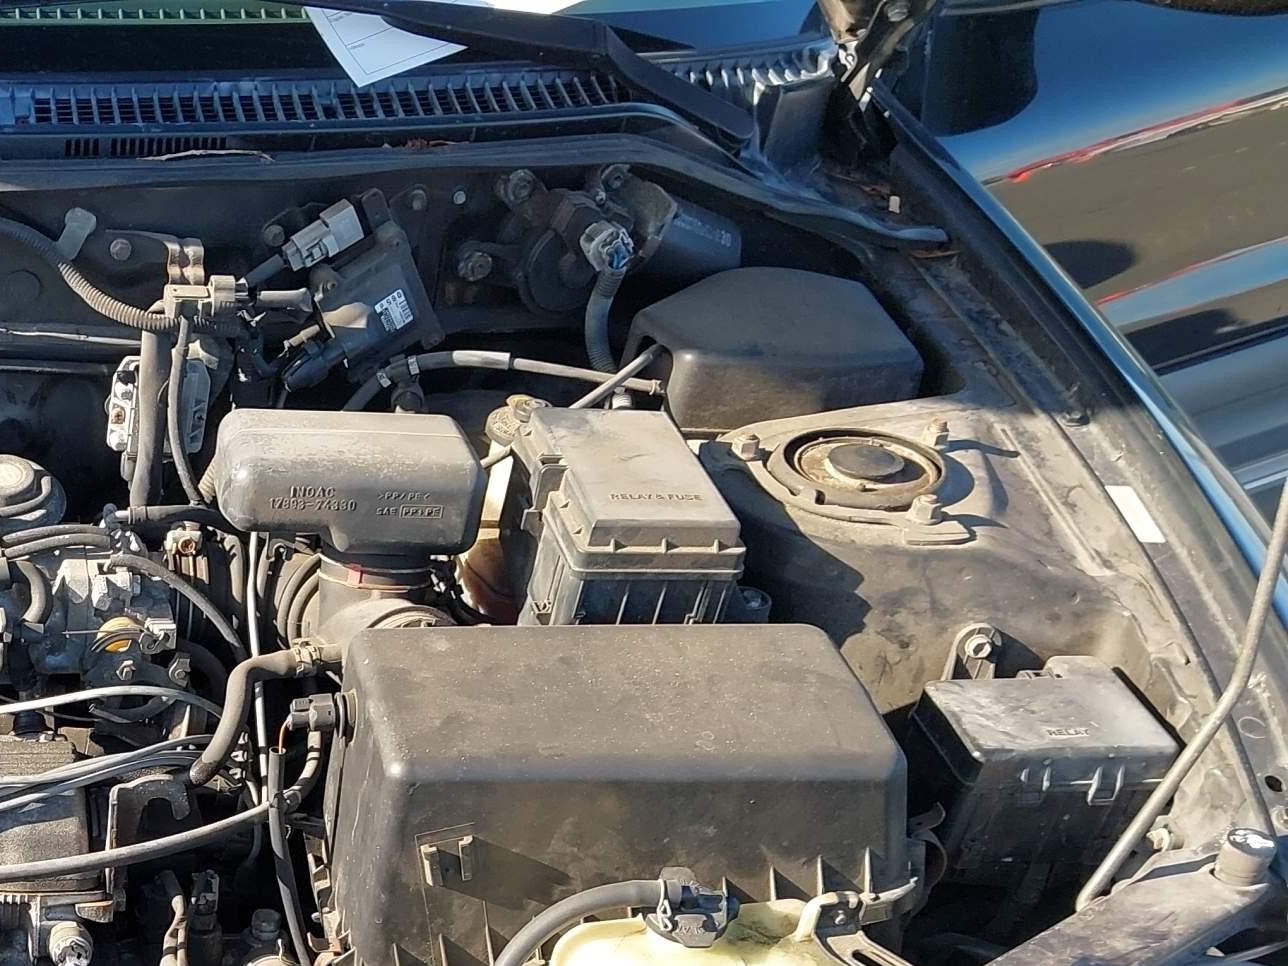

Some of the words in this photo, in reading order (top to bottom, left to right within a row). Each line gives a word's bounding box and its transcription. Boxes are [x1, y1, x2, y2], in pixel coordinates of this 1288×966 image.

[289, 486, 336, 498] INOAC
[667, 493, 704, 501] FUSE
[1046, 728, 1089, 736] RELAY
